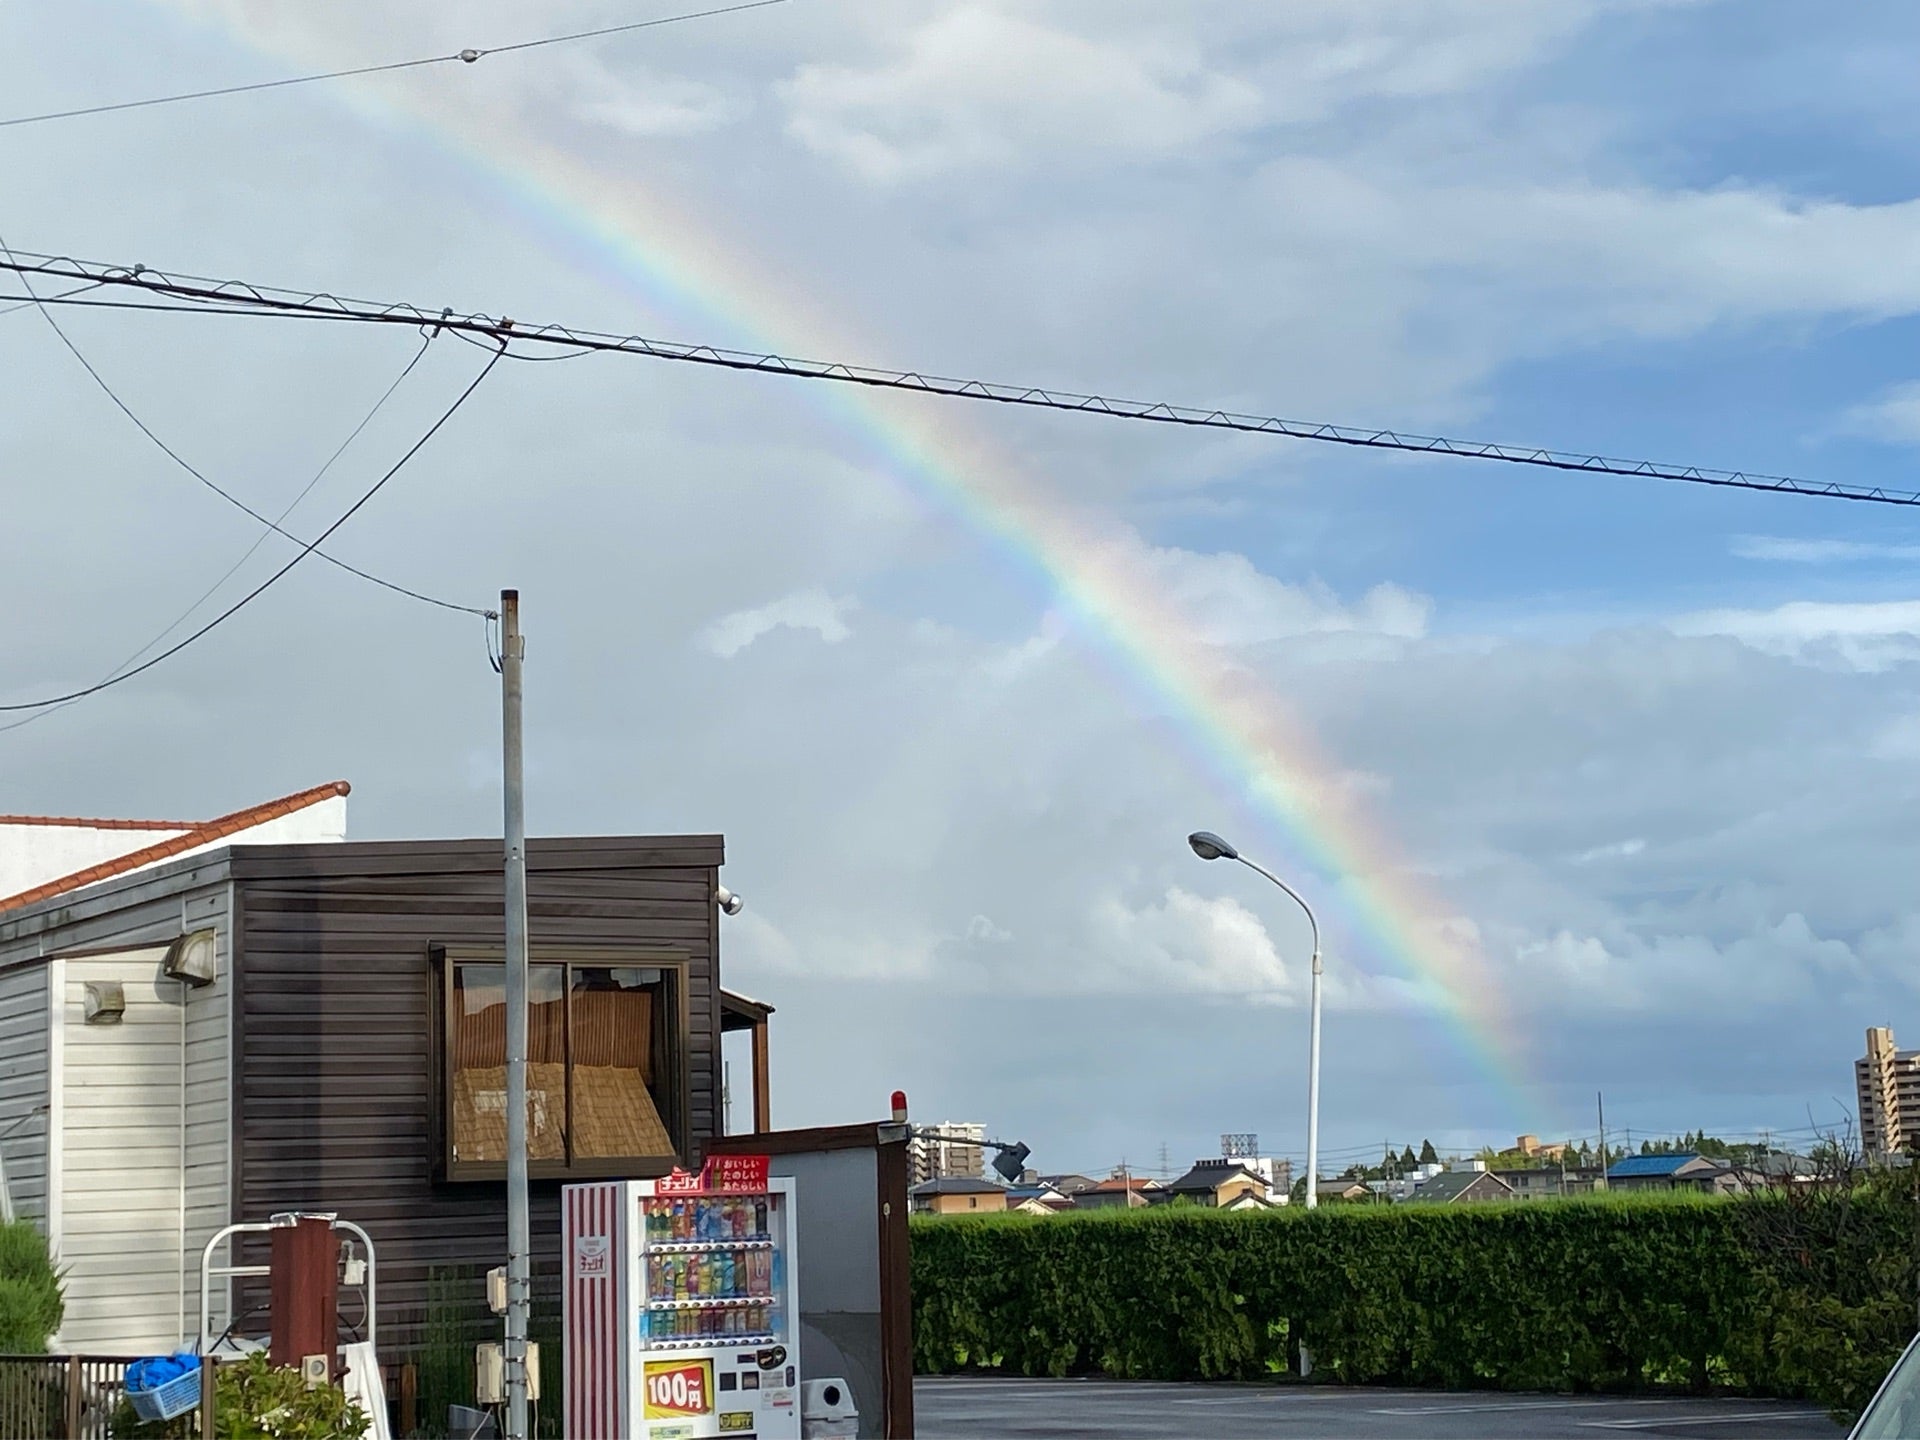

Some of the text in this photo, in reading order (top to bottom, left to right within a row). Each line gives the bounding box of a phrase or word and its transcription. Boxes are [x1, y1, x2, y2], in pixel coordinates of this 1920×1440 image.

[723, 1159, 760, 1169] おいしい
[723, 1170, 760, 1180] たのしい
[661, 1175, 700, 1191] チェリオ
[722, 1181, 766, 1192] あたらしい
